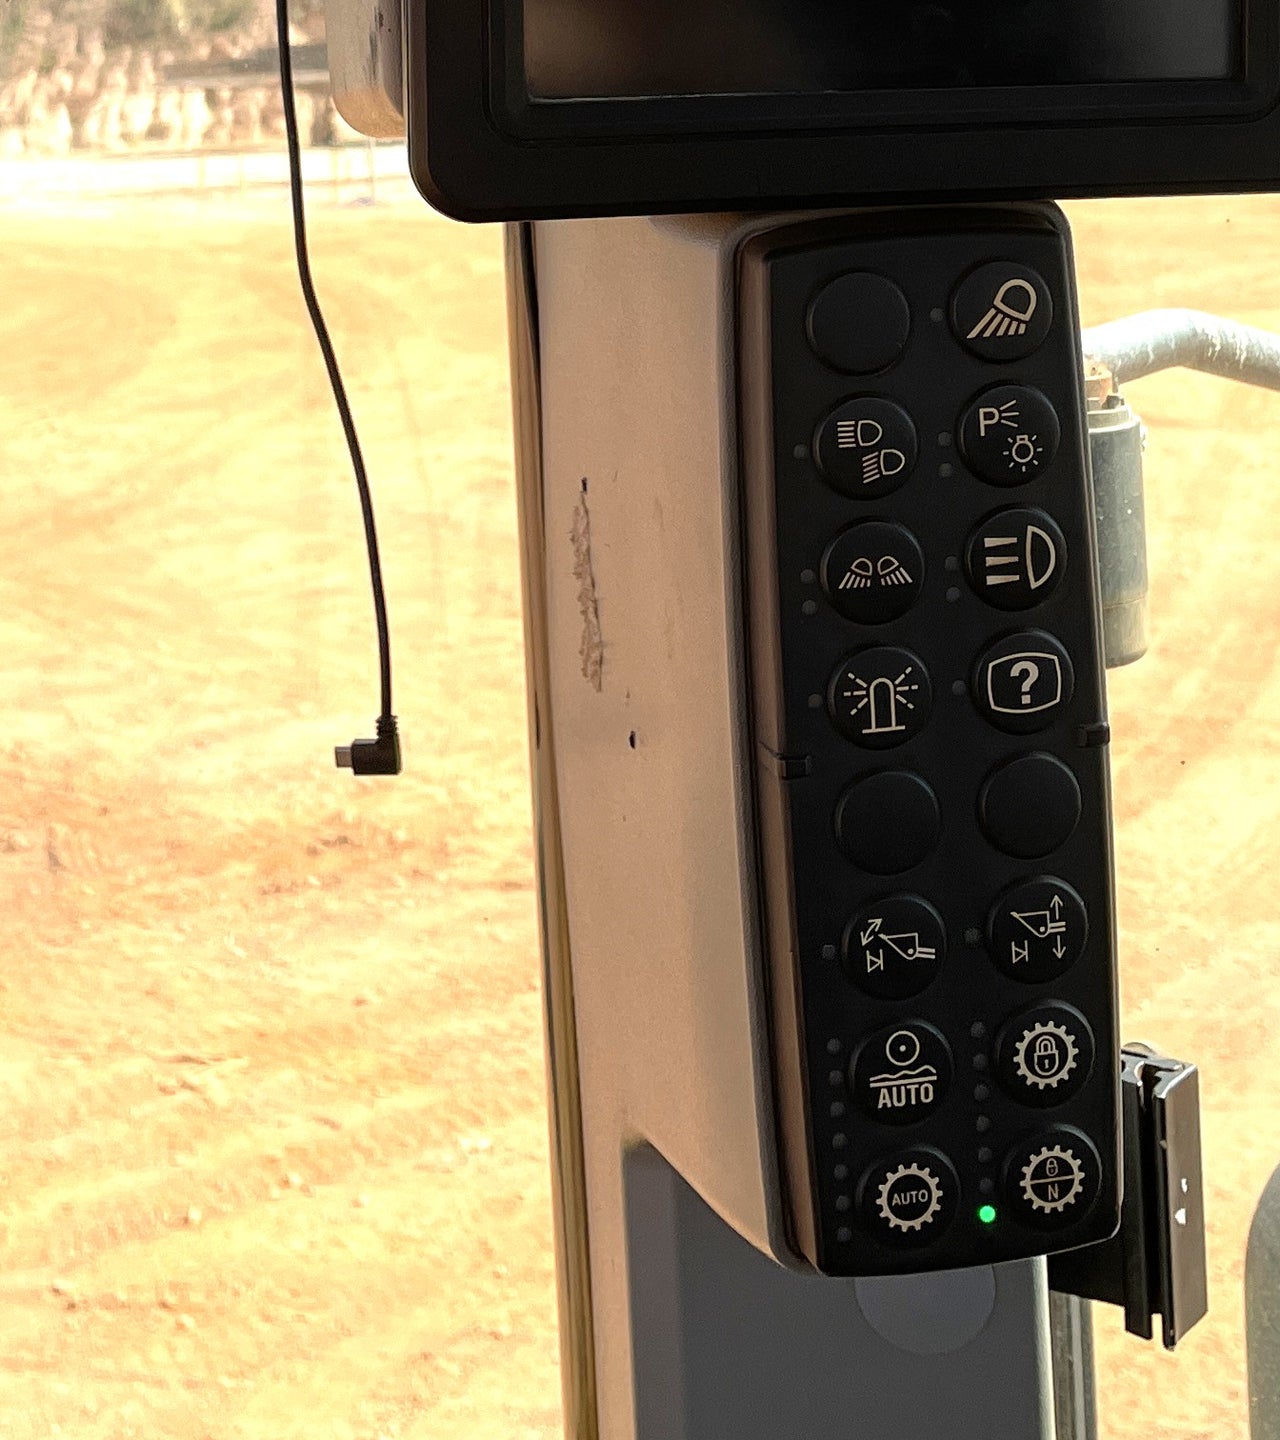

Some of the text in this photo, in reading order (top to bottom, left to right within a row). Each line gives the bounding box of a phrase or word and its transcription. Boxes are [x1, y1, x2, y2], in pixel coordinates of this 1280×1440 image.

[979, 407, 1000, 437] P
[877, 1082, 934, 1109] AUTO
[891, 1190, 929, 1207] AUTO
[1047, 1183, 1059, 1201] N
